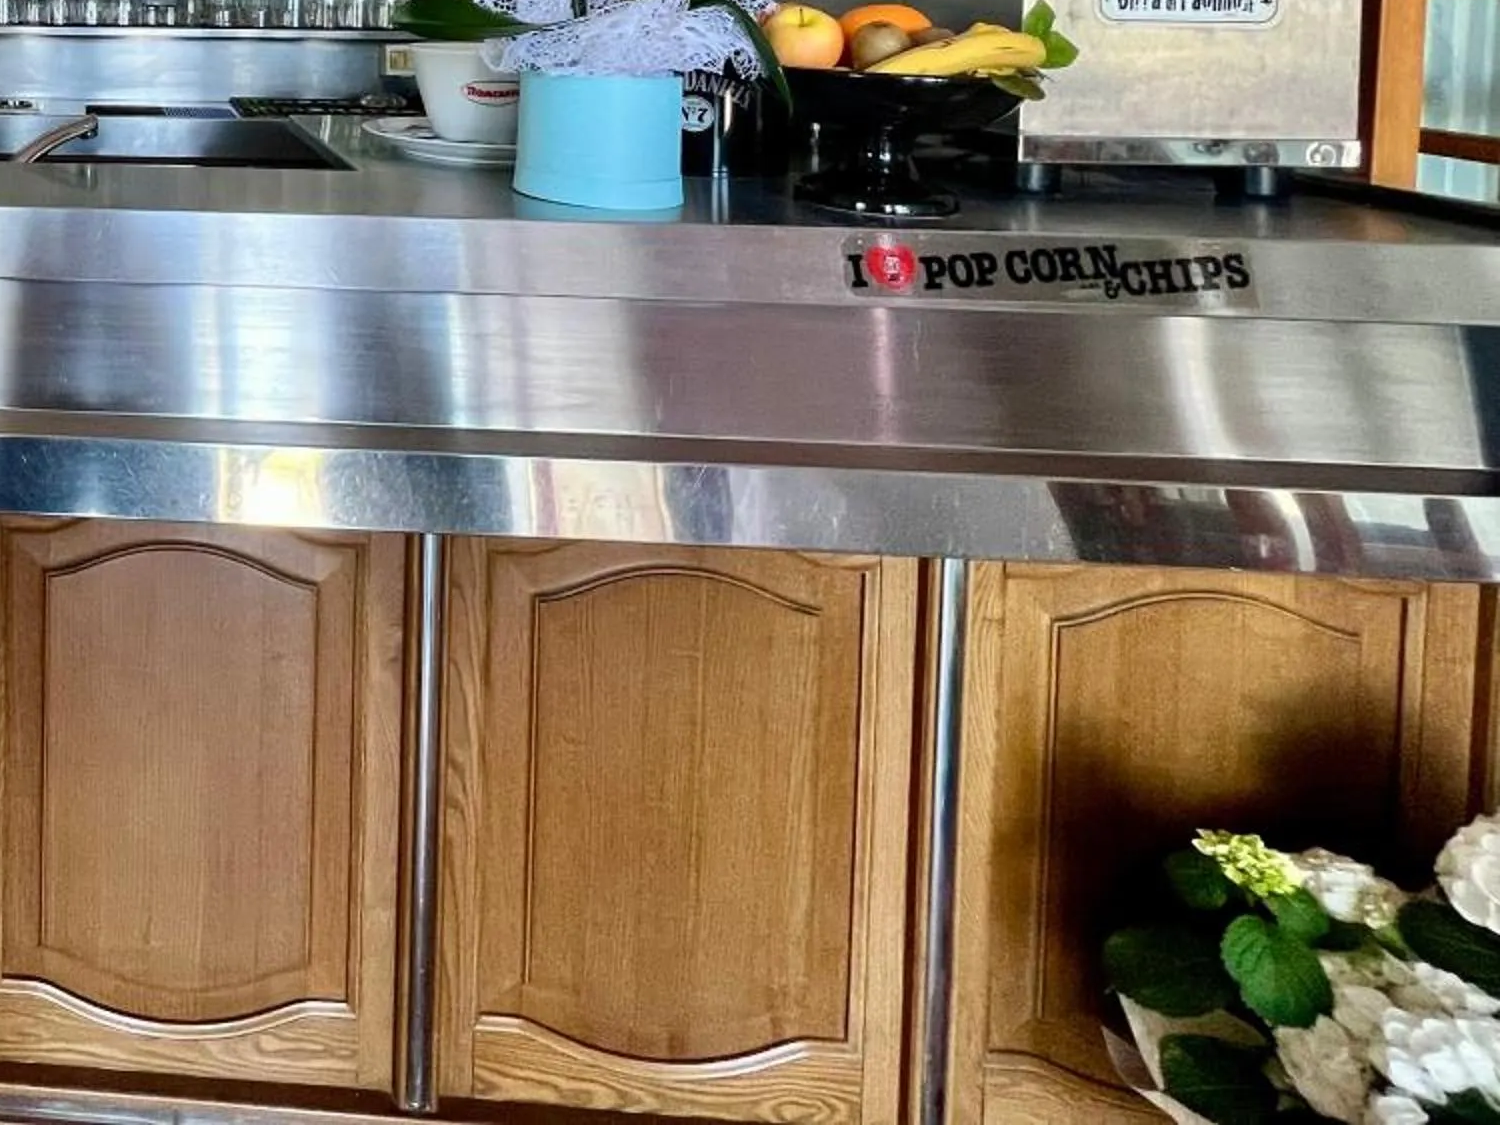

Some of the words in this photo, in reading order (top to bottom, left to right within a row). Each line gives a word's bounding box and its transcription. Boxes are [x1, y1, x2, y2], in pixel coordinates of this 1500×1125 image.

[847, 254, 868, 288] I
[920, 253, 998, 290] POP
[1005, 244, 1119, 285] CORN
[1103, 279, 1121, 300] &
[1119, 252, 1251, 296] CHIPS
